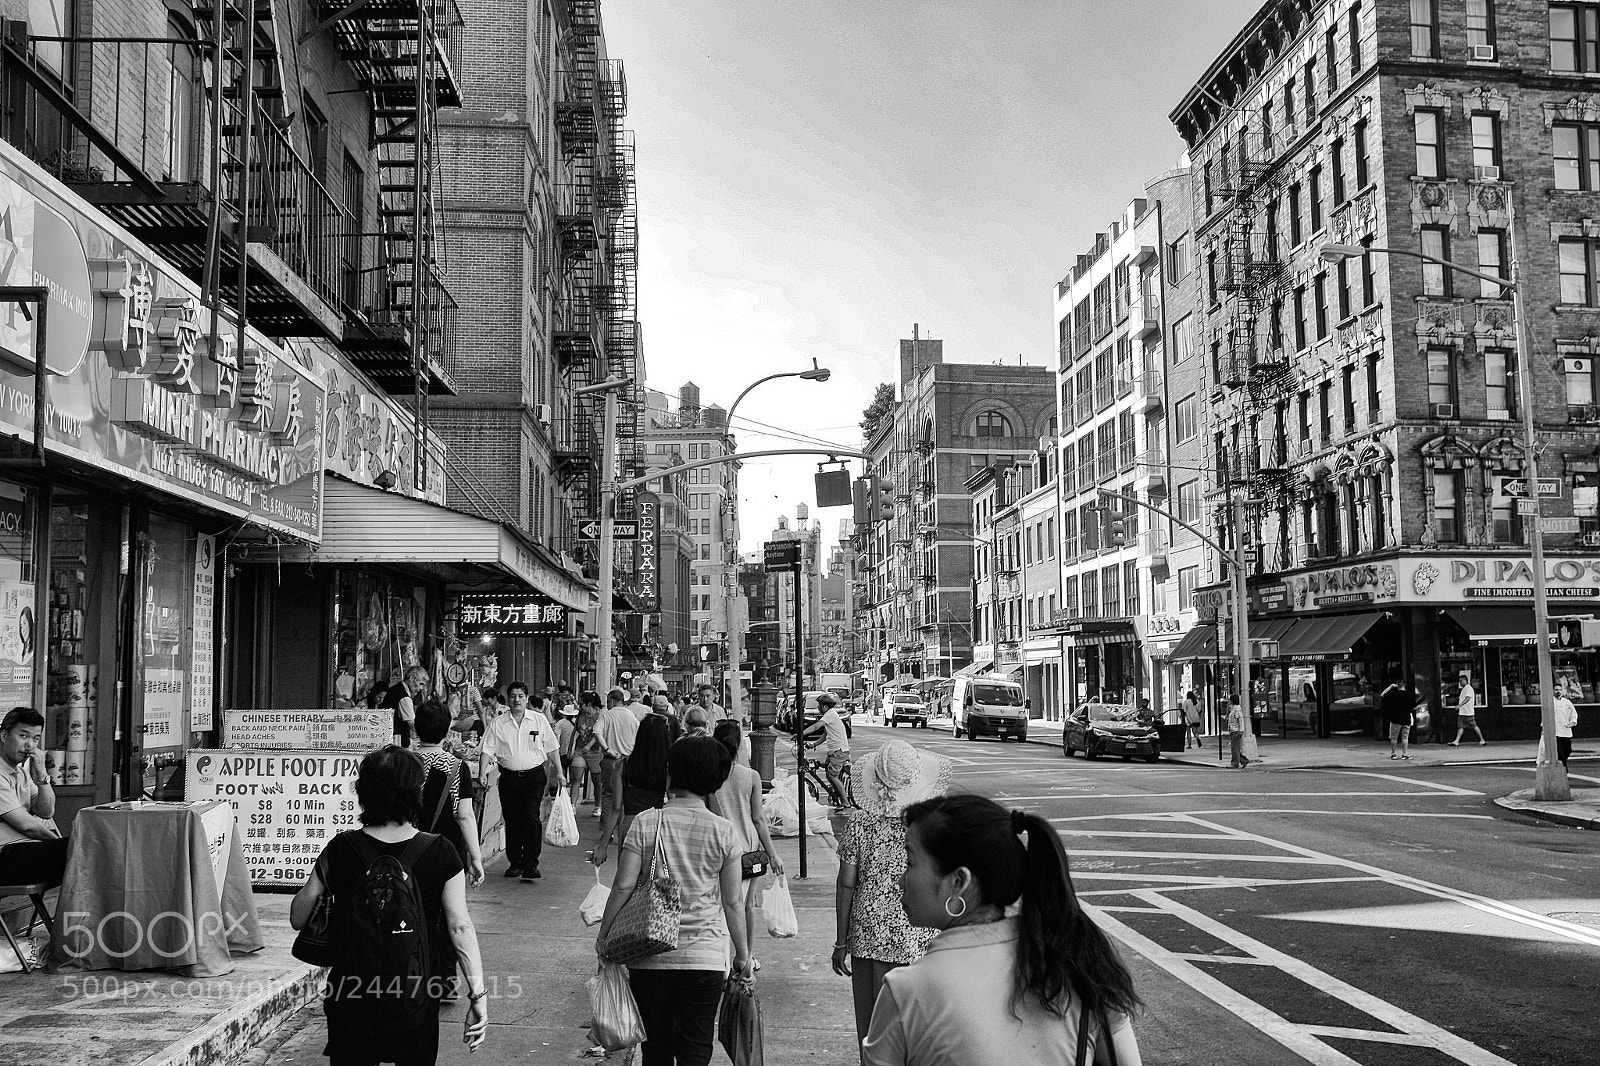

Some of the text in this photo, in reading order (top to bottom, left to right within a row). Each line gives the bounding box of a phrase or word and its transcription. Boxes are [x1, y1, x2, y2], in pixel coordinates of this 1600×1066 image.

[58, 408, 83, 439] 10013
[142, 378, 196, 446] MINH
[200, 407, 288, 487] PHARMACY
[1509, 483, 1526, 492] ONE
[587, 525, 602, 535] ON
[1544, 520, 1570, 531] MOTT
[639, 502, 656, 599] FERRARA
[1451, 560, 1487, 583] DI
[1473, 588, 1492, 597] FINE
[1493, 588, 1532, 597] IMPORTED
[1565, 588, 1593, 597] CHEESE
[461, 603, 563, 625] 新東方畫廊
[242, 714, 324, 723] CHINESE THERAPY
[219, 757, 360, 777] APPLE FOOT SPA
[215, 783, 343, 796] FOOT BACK
[258, 800, 273, 811] $8
[286, 799, 355, 812] 10 Min $8
[250, 813, 272, 825] $28
[285, 814, 355, 825] 60 Min $32
[245, 856, 276, 865] 30AM
[285, 856, 316, 865] 9:00P
[250, 868, 312, 880] 12-966-
